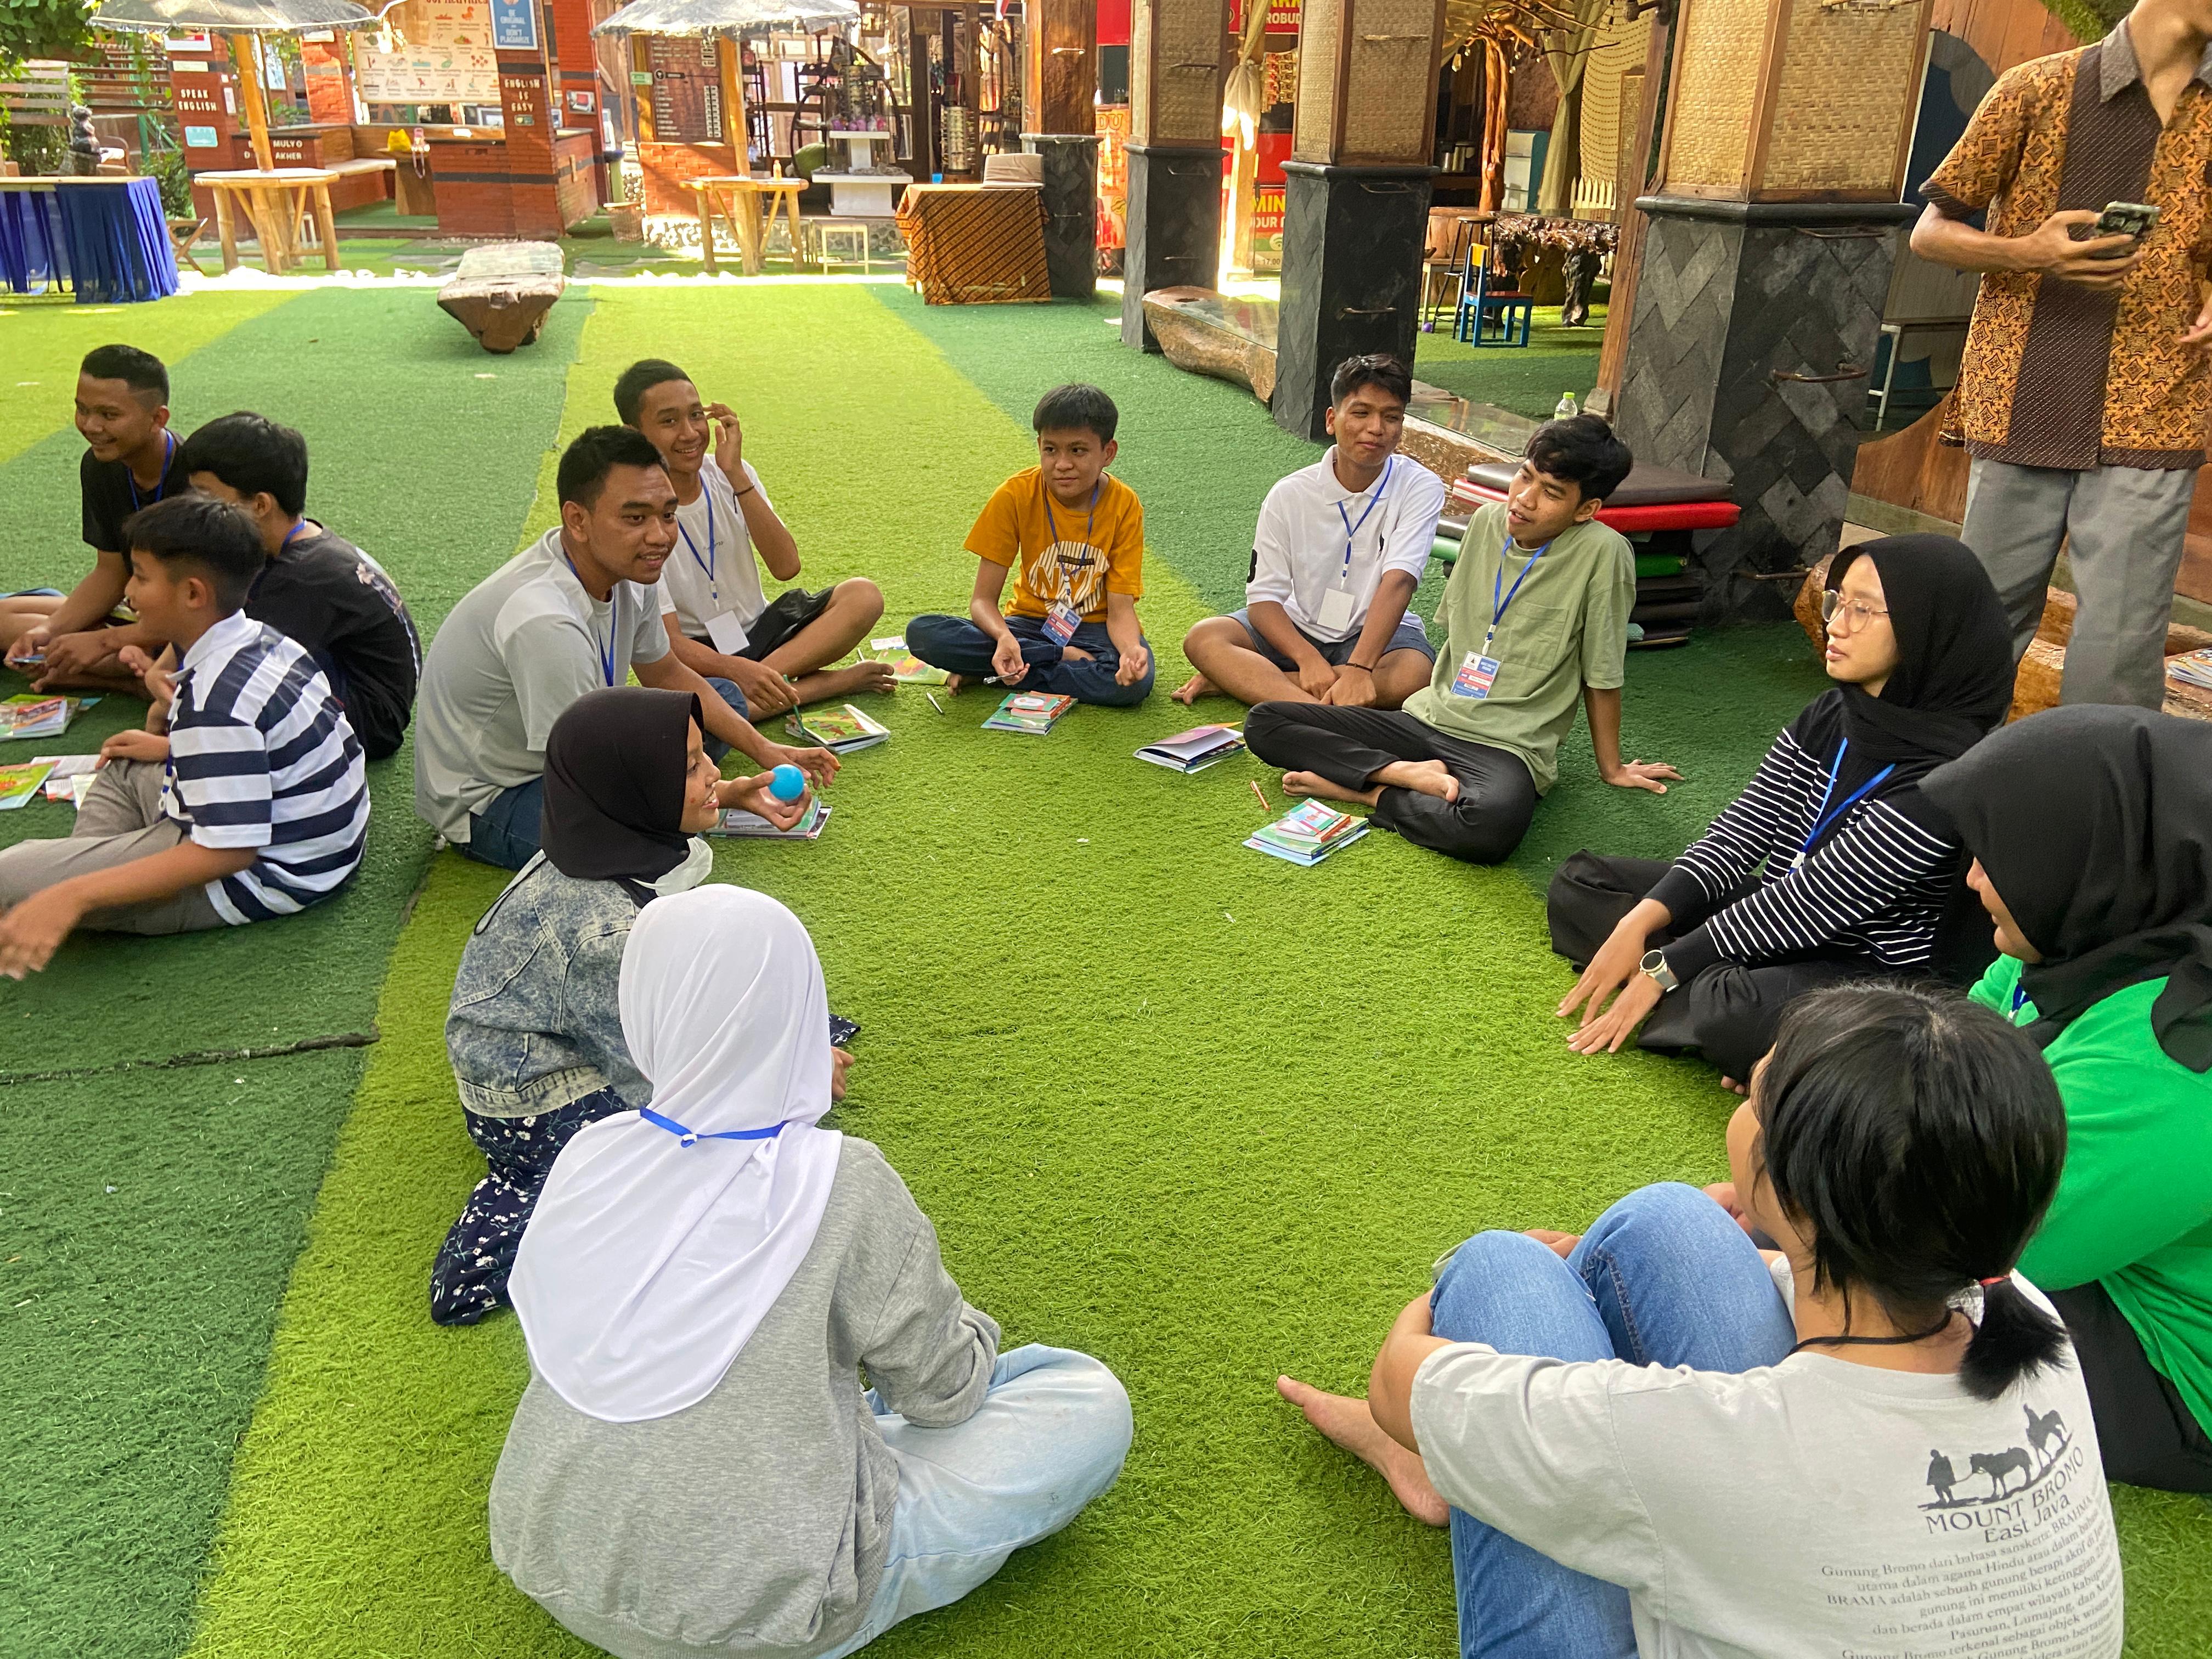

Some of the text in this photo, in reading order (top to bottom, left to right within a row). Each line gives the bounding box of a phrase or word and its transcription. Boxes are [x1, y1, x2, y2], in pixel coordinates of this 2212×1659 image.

[504, 78, 540, 88] ENGLISH
[180, 89, 208, 99] SPEAK
[519, 91, 529, 101] IS
[178, 100, 217, 111] ENGLISH
[511, 102, 534, 112] EASY
[273, 139, 303, 148] MULYO
[275, 151, 302, 161] AKHER
[1926, 1499, 2023, 1534] MOUNT
[2032, 1447, 2083, 1509] BROMO
[1984, 1494, 2070, 1543] East Java
[1822, 1566, 1879, 1578] Gunung
[1882, 1564, 1926, 1575] Bromo
[1857, 1582, 1898, 1592] utama
[1902, 1575, 1940, 1588] dalam
[1943, 1568, 1982, 1582] agama
[1987, 1556, 2024, 1573] Hindu
[1891, 1590, 1930, 1605] adalah
[1982, 1571, 2028, 1591] gunung
[1920, 1600, 1966, 1618] gunung
[1968, 1594, 1985, 1606] ini
[1989, 1583, 2042, 1602] memiliki
[2077, 1591, 2096, 1606] dan
[1872, 1624, 1898, 1635] dan
[2028, 1586, 2070, 1608] wilayah
